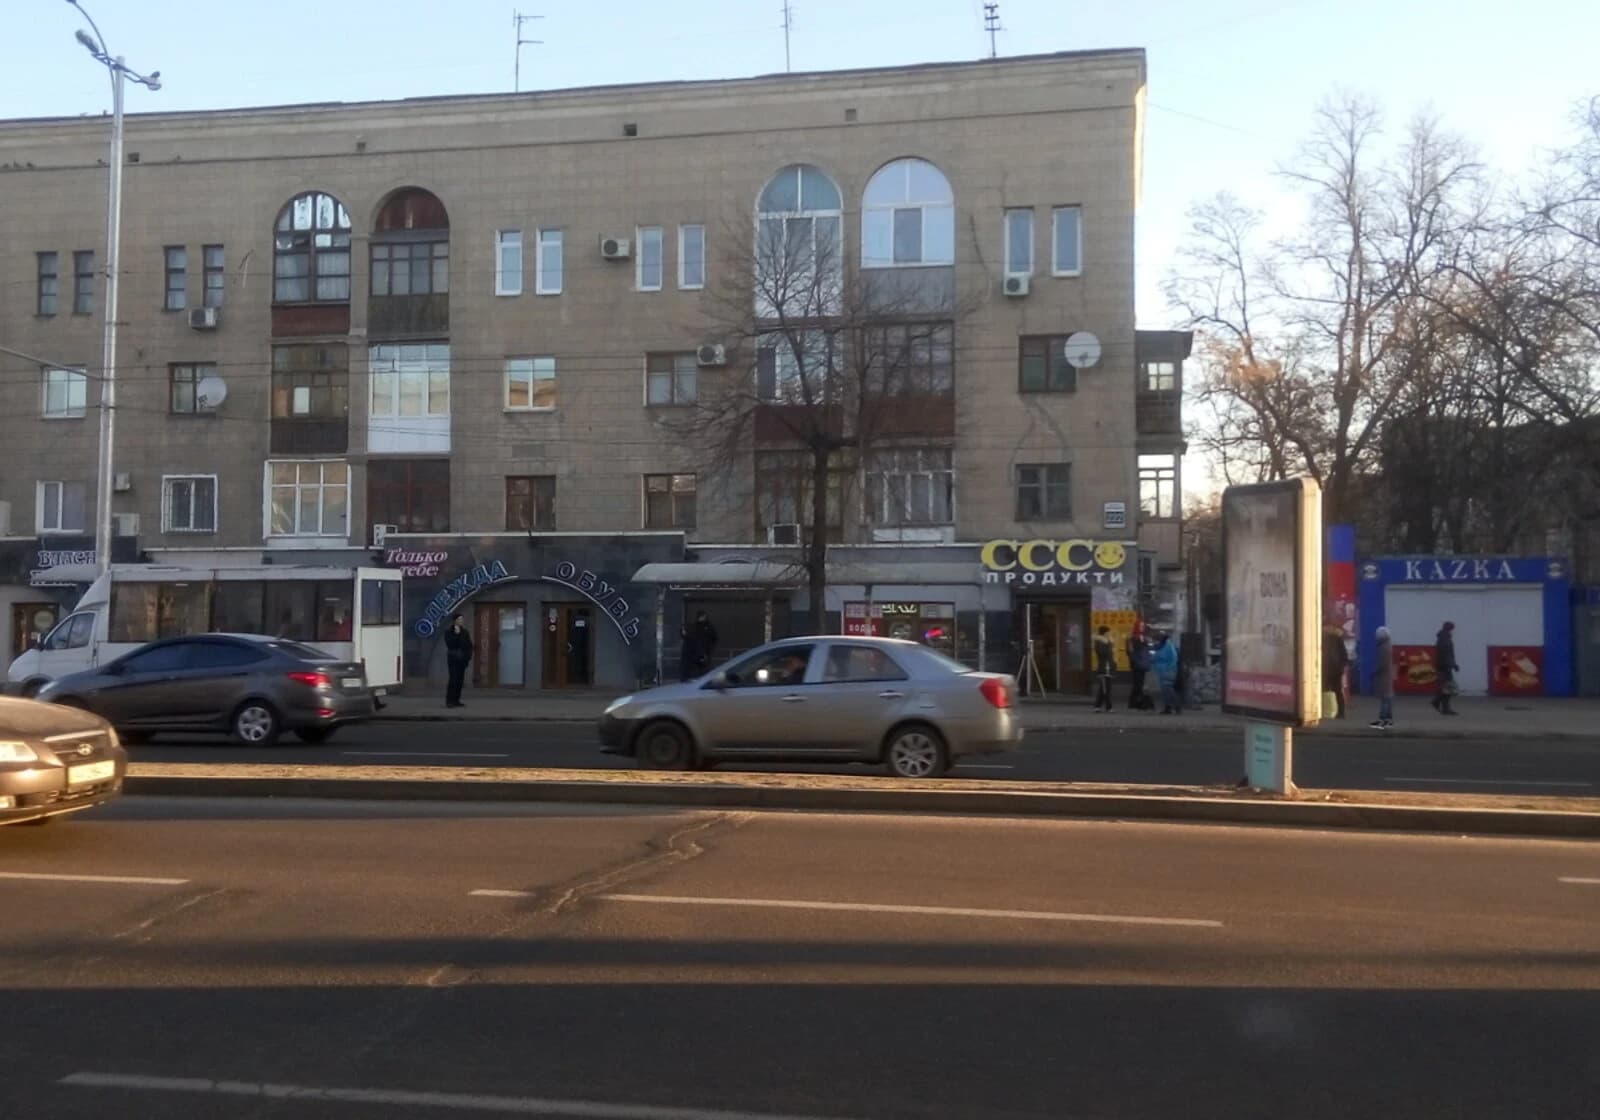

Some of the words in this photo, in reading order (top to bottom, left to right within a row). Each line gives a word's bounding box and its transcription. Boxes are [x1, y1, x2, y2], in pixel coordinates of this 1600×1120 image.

[986, 572, 1124, 585] ПРОДУКТИ
[1406, 559, 1515, 580] KAZKA
[415, 559, 509, 638] ОДЕЖДА
[556, 560, 640, 638] ОБУВЬ
